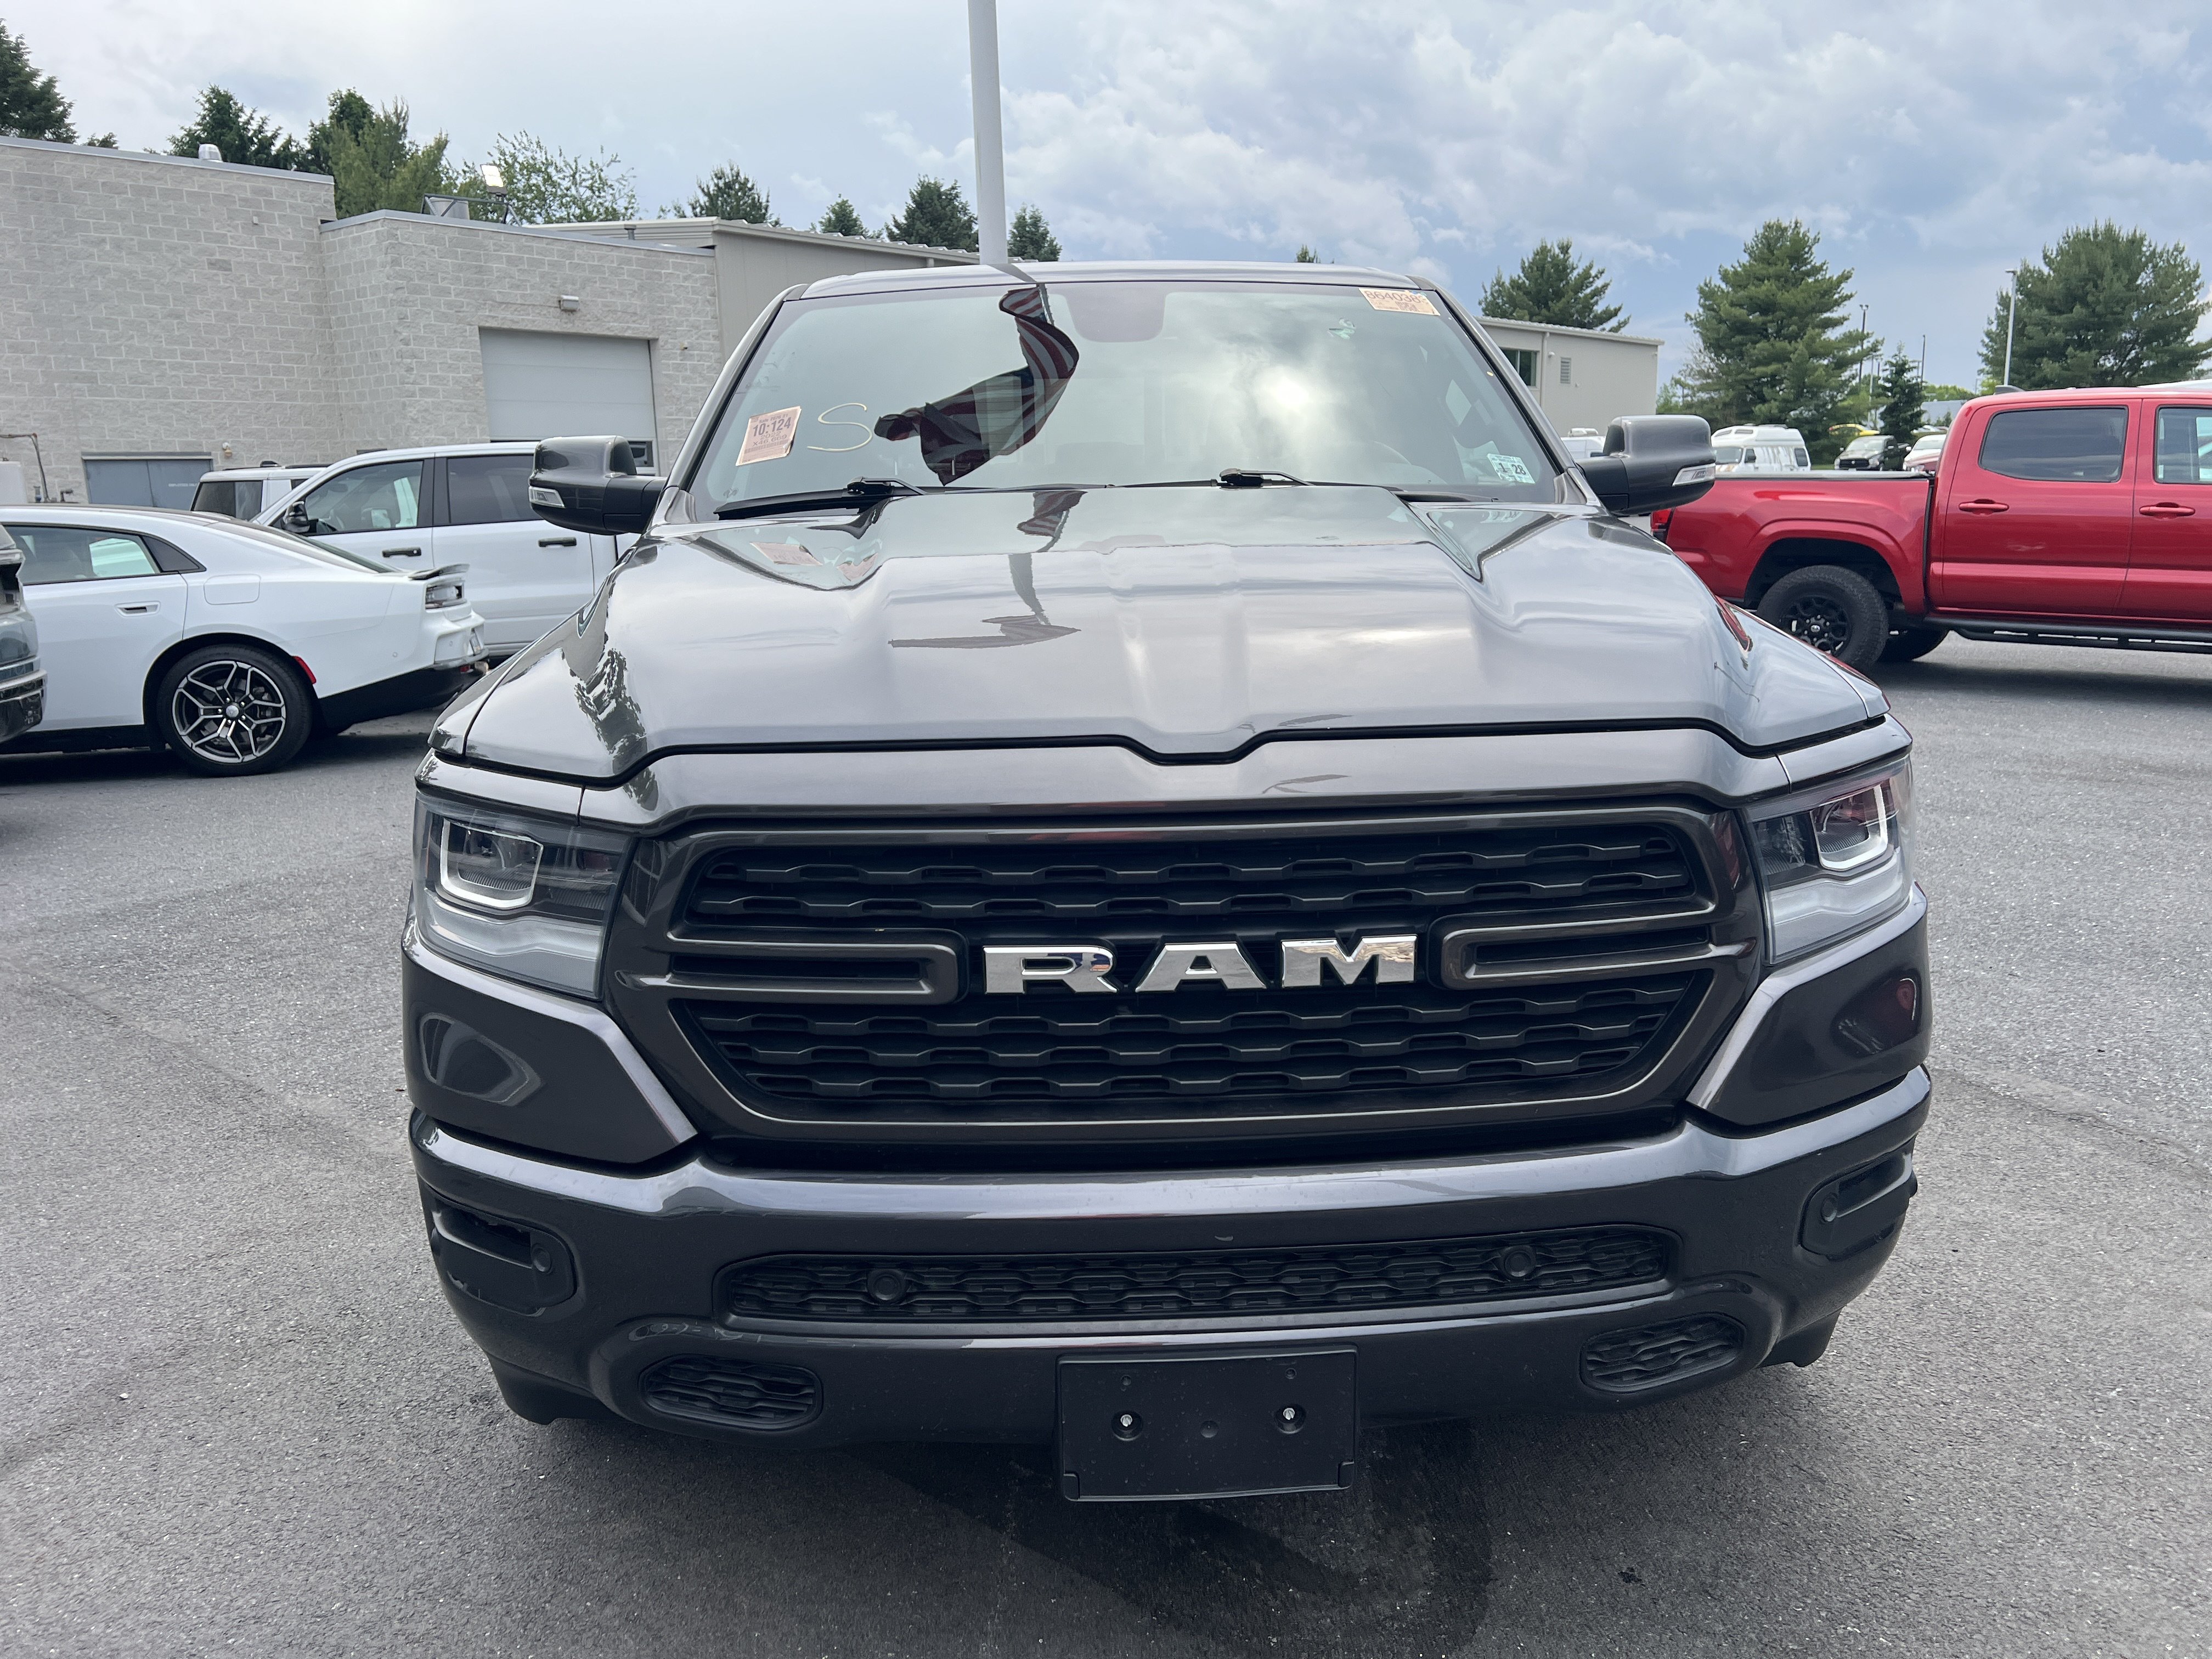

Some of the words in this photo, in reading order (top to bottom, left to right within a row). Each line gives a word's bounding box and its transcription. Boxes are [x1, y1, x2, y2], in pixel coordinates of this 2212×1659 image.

[753, 417, 792, 437] 10:124
[760, 431, 781, 440] 2022
[807, 402, 873, 452] S
[1499, 462, 1508, 473] 1
[1511, 464, 1526, 475] 28
[983, 935, 1418, 994] RAM
